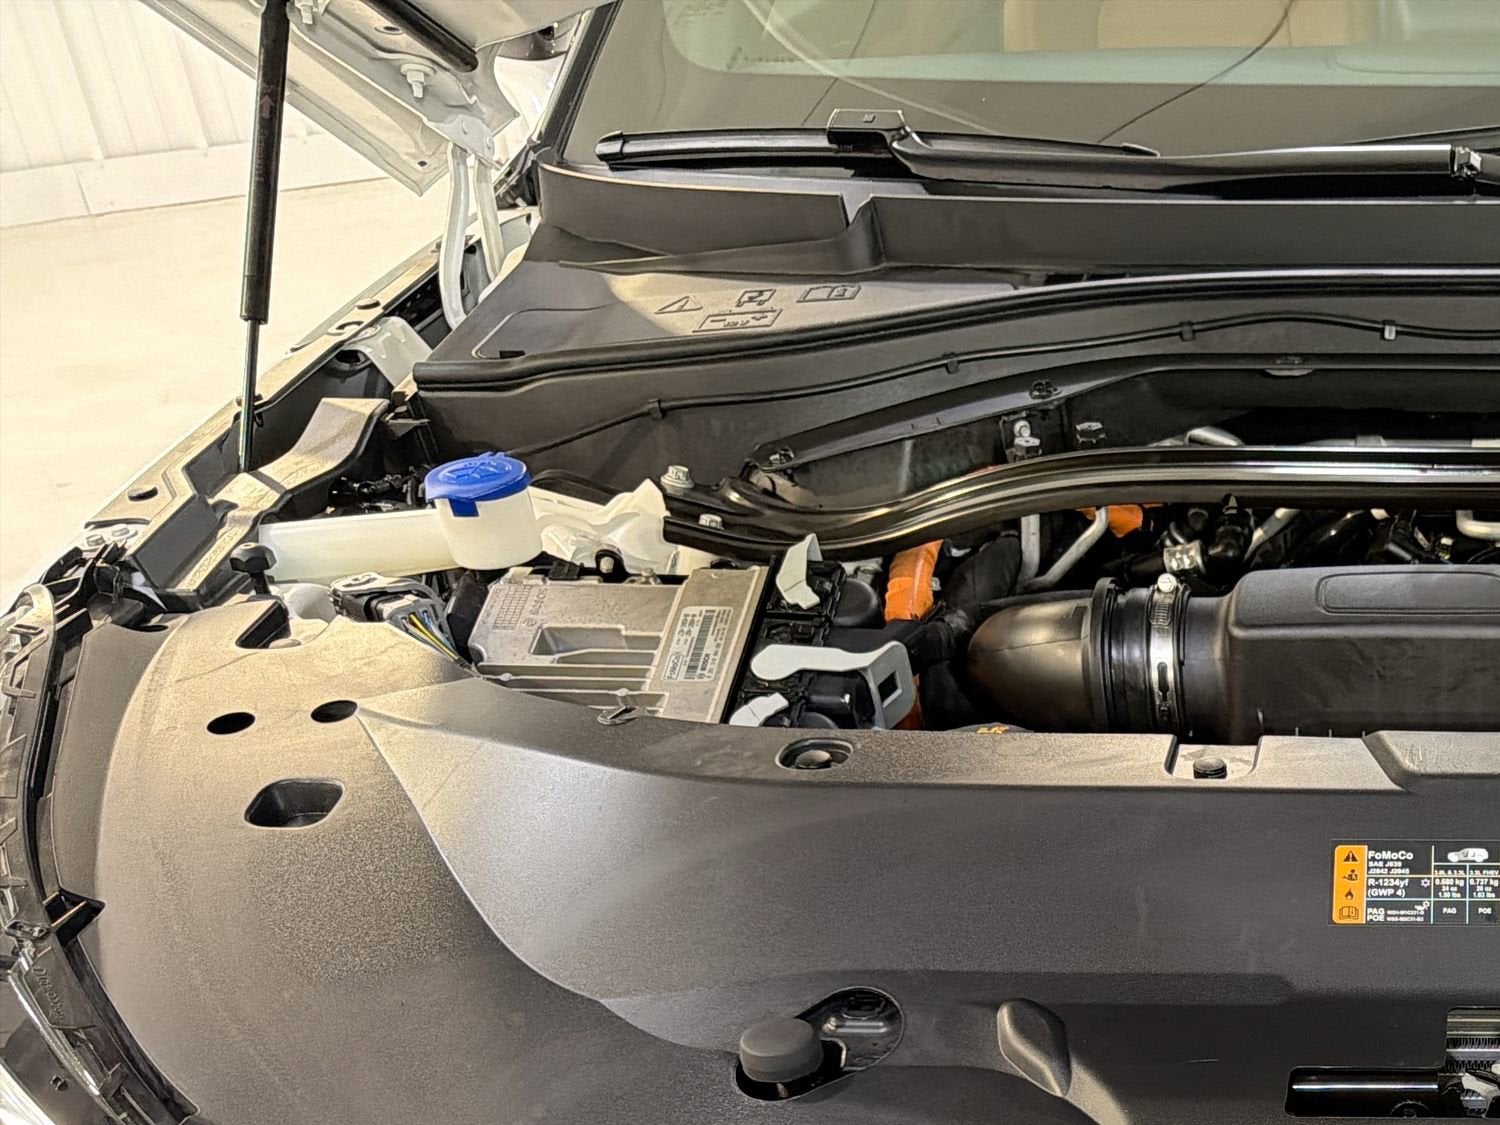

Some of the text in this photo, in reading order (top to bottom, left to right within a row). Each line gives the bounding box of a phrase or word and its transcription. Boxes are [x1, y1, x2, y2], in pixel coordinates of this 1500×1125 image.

[1368, 850, 1414, 860] FoMoCo
[1368, 878, 1409, 888] R-1234yf
[1455, 878, 1464, 887] kg
[1490, 878, 1499, 887] kg
[1367, 888, 1406, 898] (GWP 4)
